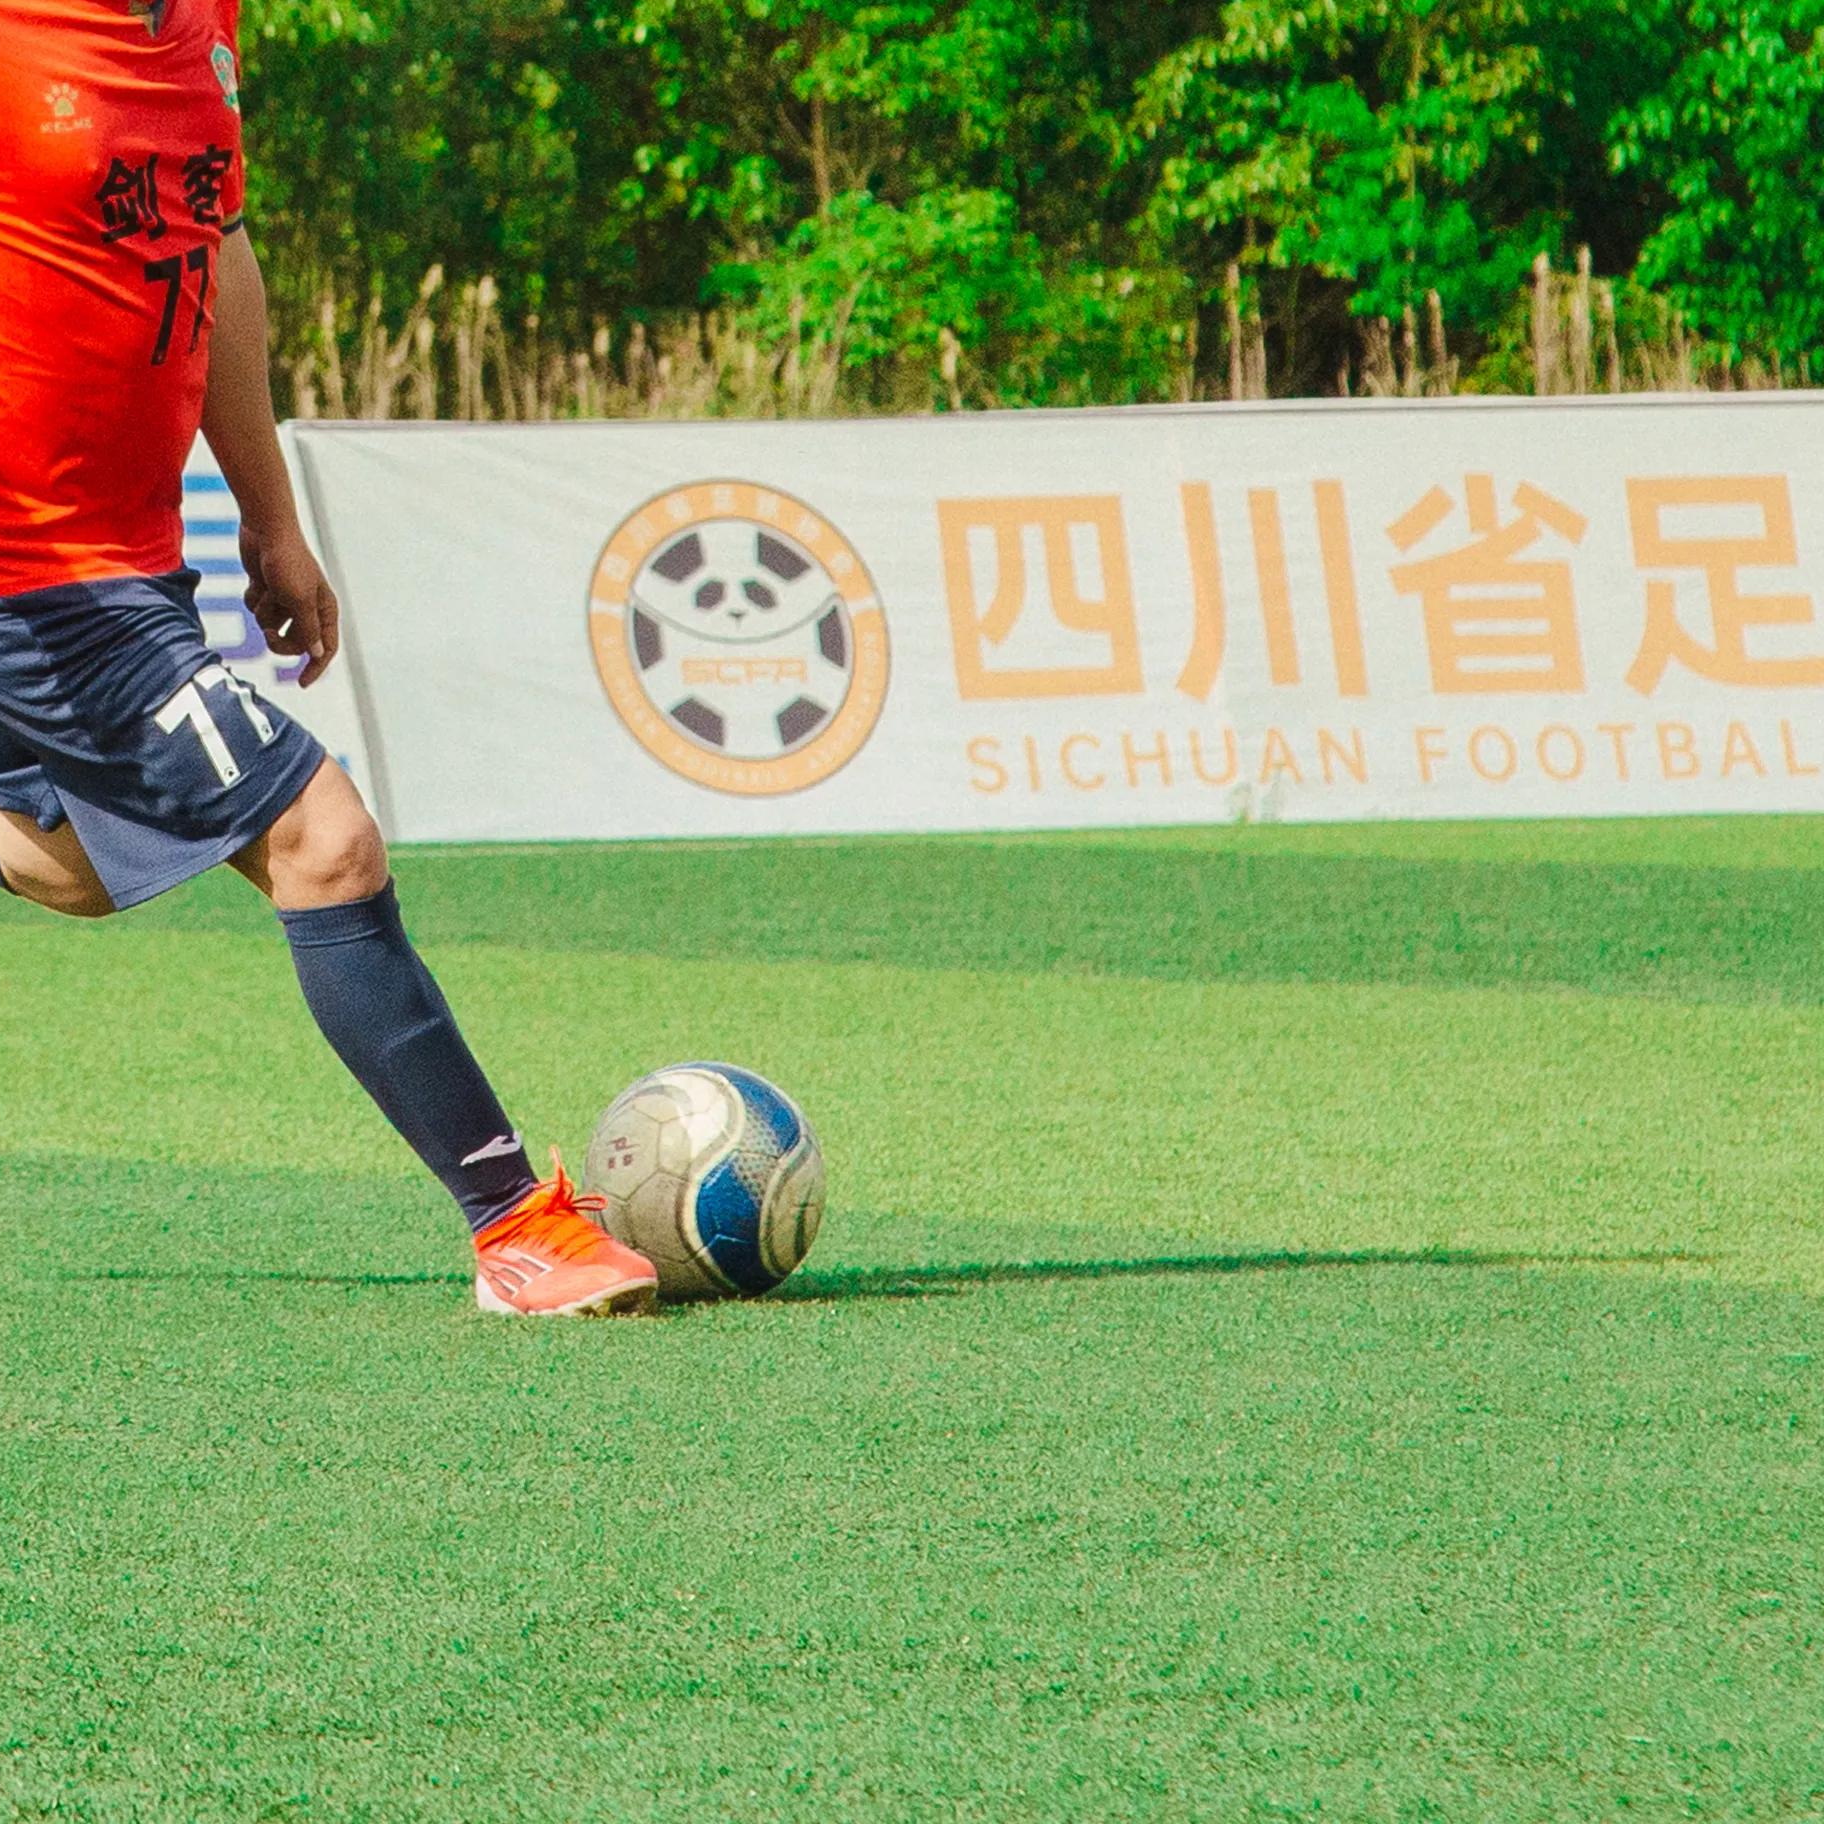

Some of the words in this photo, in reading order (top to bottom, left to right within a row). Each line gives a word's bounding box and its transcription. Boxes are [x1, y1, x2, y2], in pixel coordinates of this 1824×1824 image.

[95, 143, 233, 243] 剑客
[143, 243, 210, 366] 77
[154, 663, 275, 789] 77
[964, 724, 1369, 794] SICHUAN
